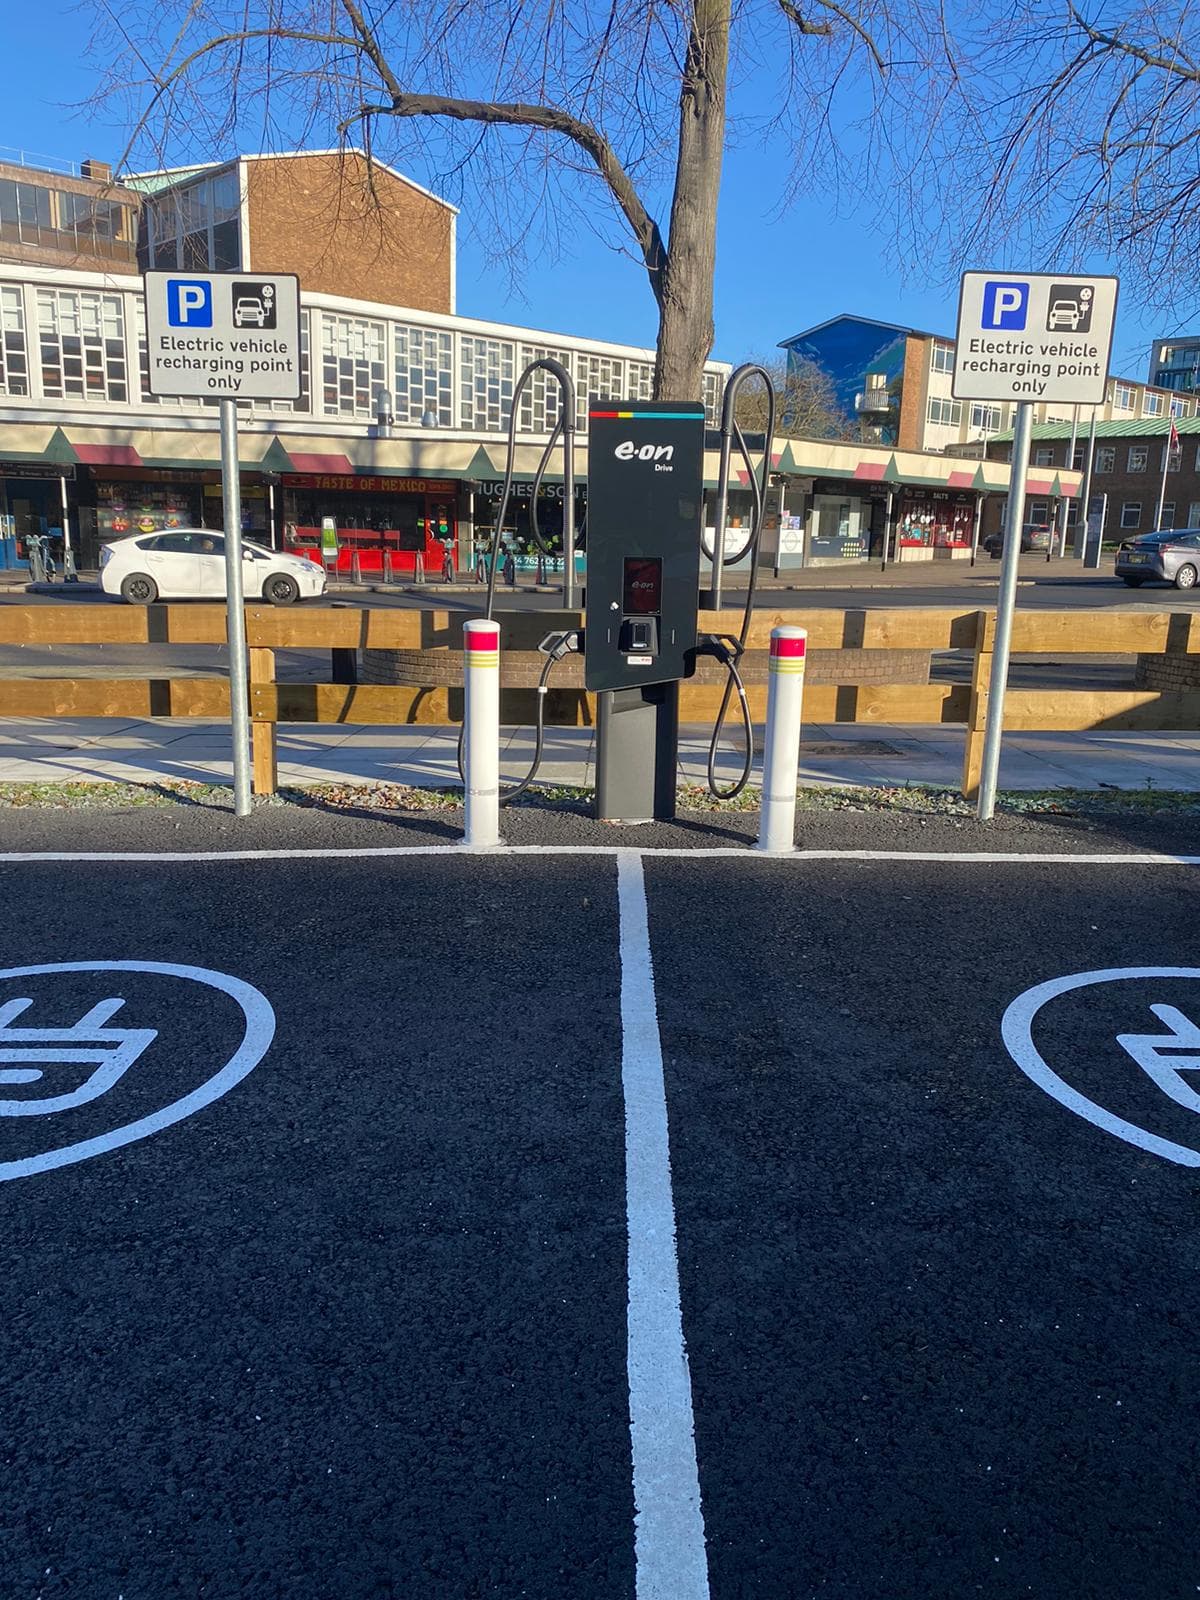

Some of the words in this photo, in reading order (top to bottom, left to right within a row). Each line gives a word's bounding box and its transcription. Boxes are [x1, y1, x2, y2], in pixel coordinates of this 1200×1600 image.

[178, 285, 205, 323] P
[992, 287, 1022, 326] P
[160, 336, 224, 351] Electric
[230, 339, 288, 354] vehicle
[969, 339, 1034, 355] Electric
[1040, 343, 1098, 358] vehicle
[156, 356, 244, 373] recharging
[250, 358, 293, 373] point
[962, 359, 1051, 377] recharging
[1057, 362, 1100, 378] point
[207, 375, 242, 391] only
[1011, 379, 1047, 395] only
[654, 463, 674, 472] Drive
[315, 476, 353, 489] TASTE
[360, 478, 376, 490] OF
[381, 479, 426, 492] MEXICO
